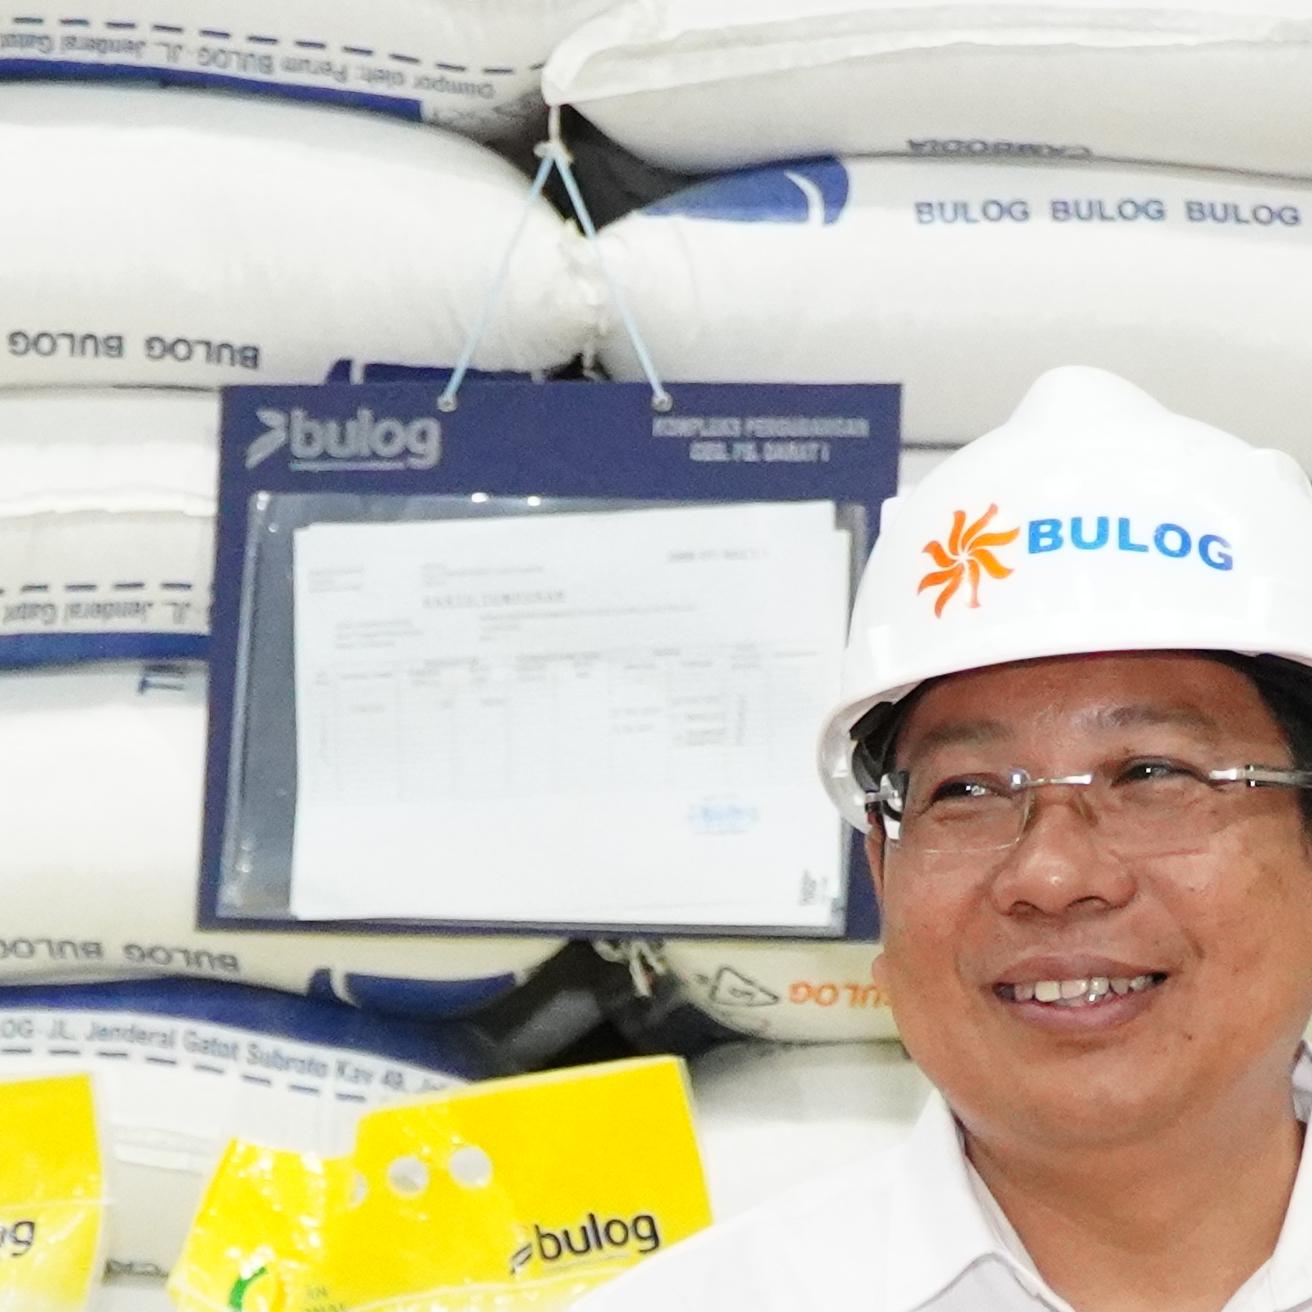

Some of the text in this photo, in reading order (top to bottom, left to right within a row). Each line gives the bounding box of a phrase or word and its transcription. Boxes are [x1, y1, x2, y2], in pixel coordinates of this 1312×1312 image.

[914, 200, 1029, 225] BULOG
[1050, 199, 1165, 223] BULOG
[1186, 201, 1301, 226] BULOG
[8, 331, 125, 358] BULOG
[145, 336, 260, 371] BULOG
[290, 406, 442, 469] bulog
[1027, 516, 1235, 571] BULOG
[122, 943, 238, 973] BULOG
[789, 981, 884, 1008] ULOG
[533, 1211, 661, 1263] bulog
